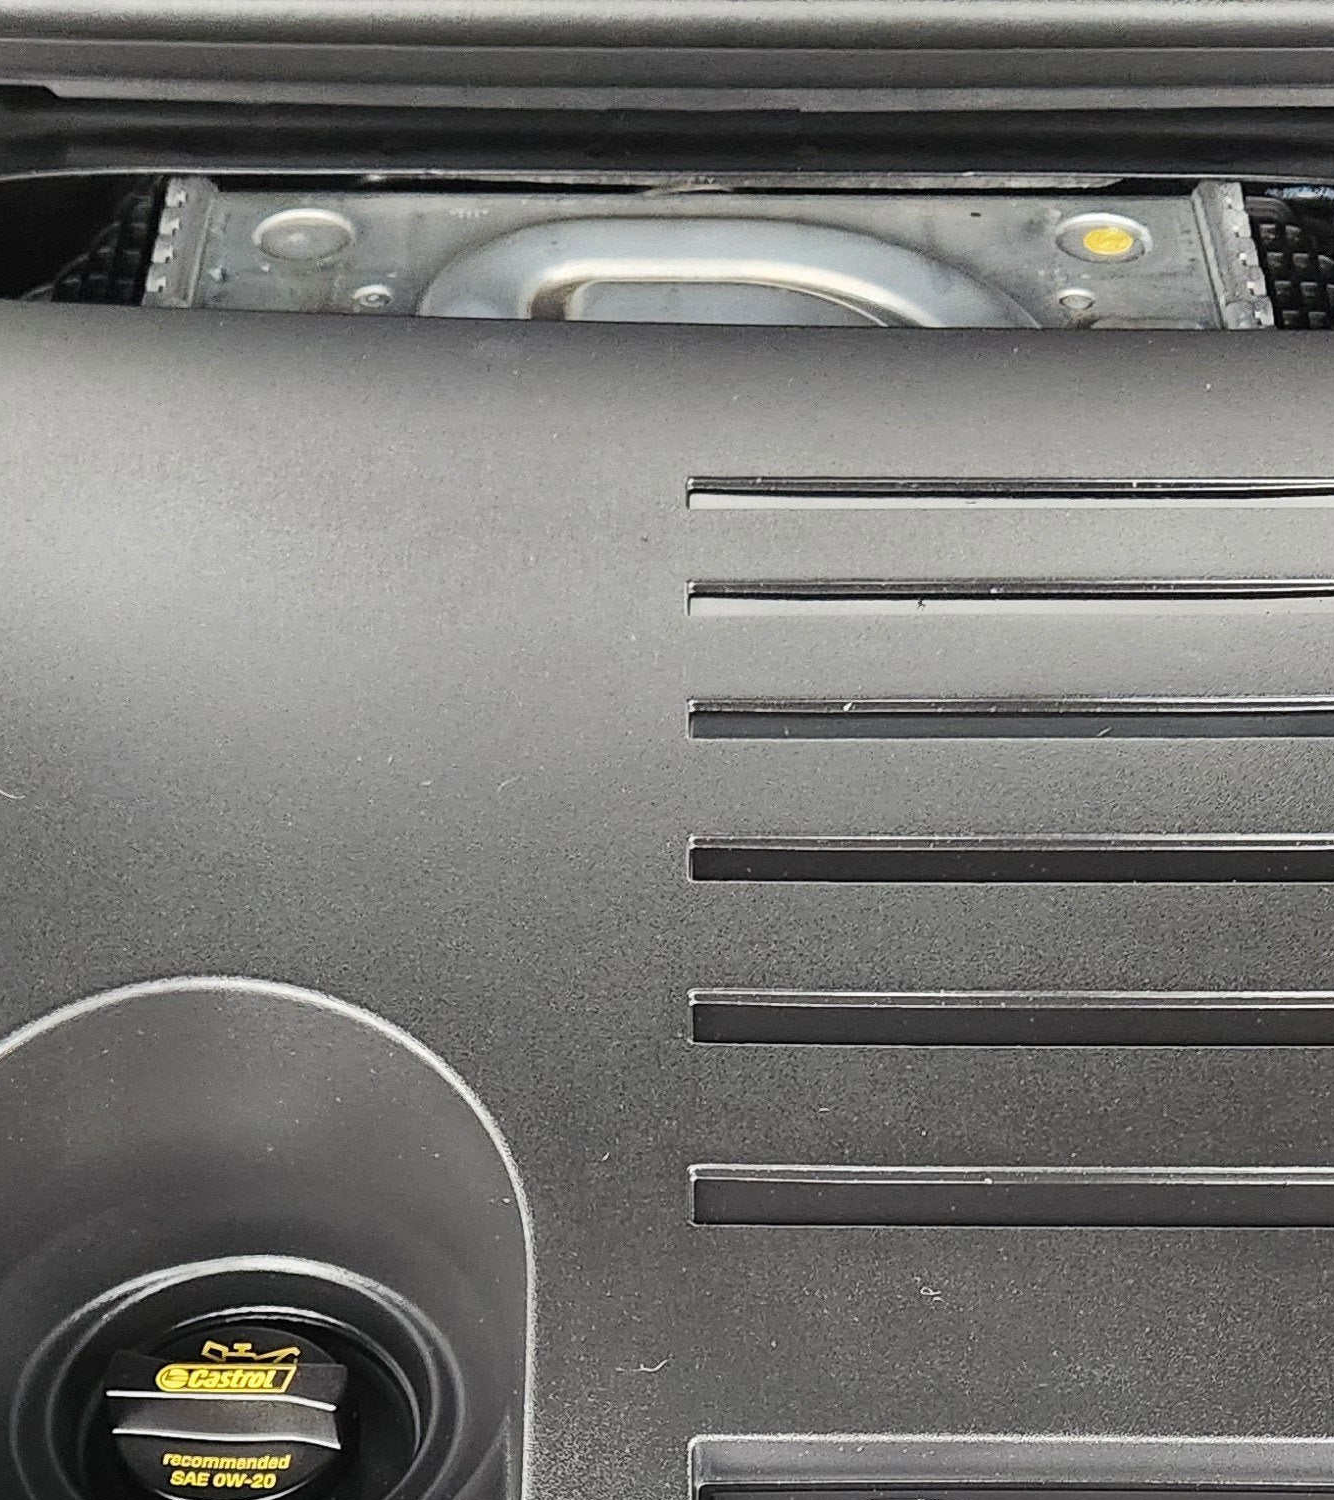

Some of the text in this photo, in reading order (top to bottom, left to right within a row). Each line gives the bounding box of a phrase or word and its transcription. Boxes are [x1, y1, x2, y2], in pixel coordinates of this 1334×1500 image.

[187, 1368, 277, 1389] Castrol
[162, 1452, 292, 1470] recommended
[170, 1470, 277, 1489] SAE 0W-20
